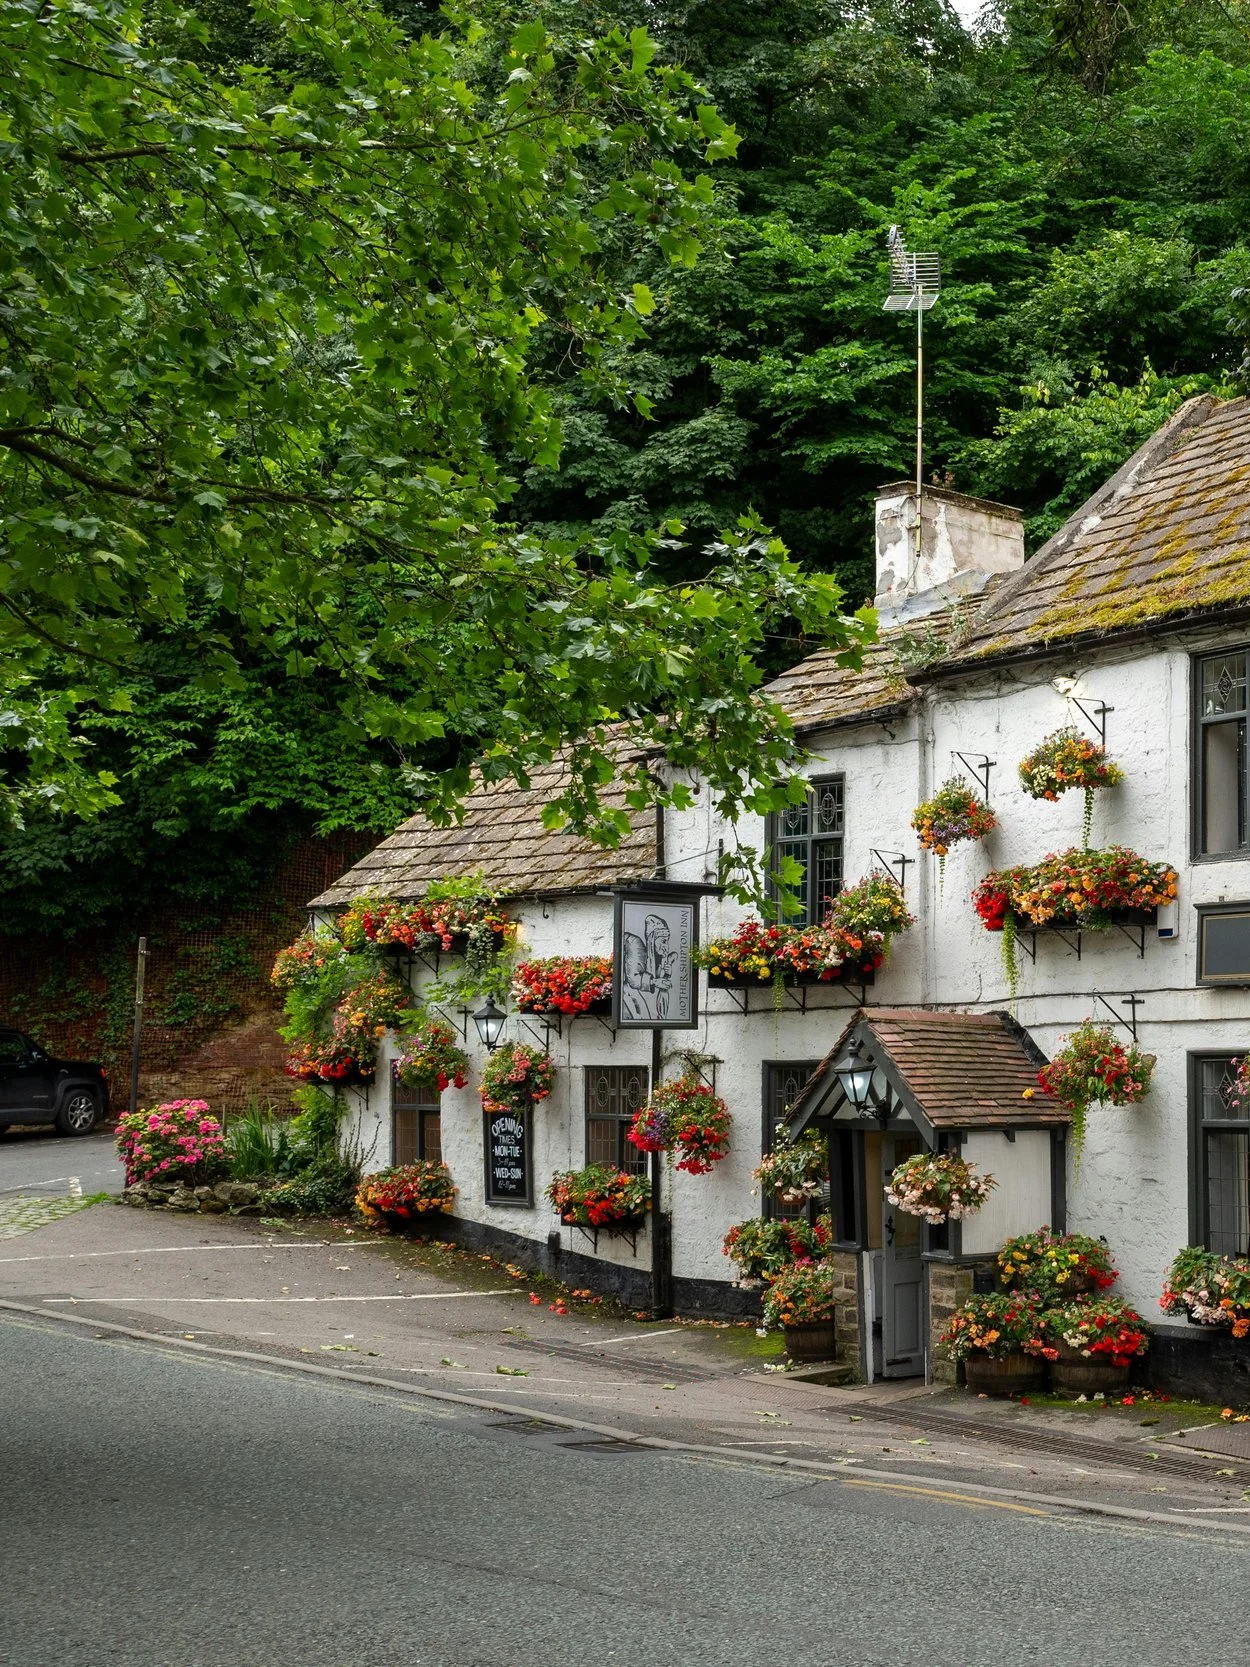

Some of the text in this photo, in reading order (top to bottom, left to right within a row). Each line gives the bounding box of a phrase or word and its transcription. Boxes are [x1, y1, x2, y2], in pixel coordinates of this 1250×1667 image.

[680, 911, 689, 1016] MOTHER SHIPTON INN
[492, 1117, 524, 1139] OPENING
